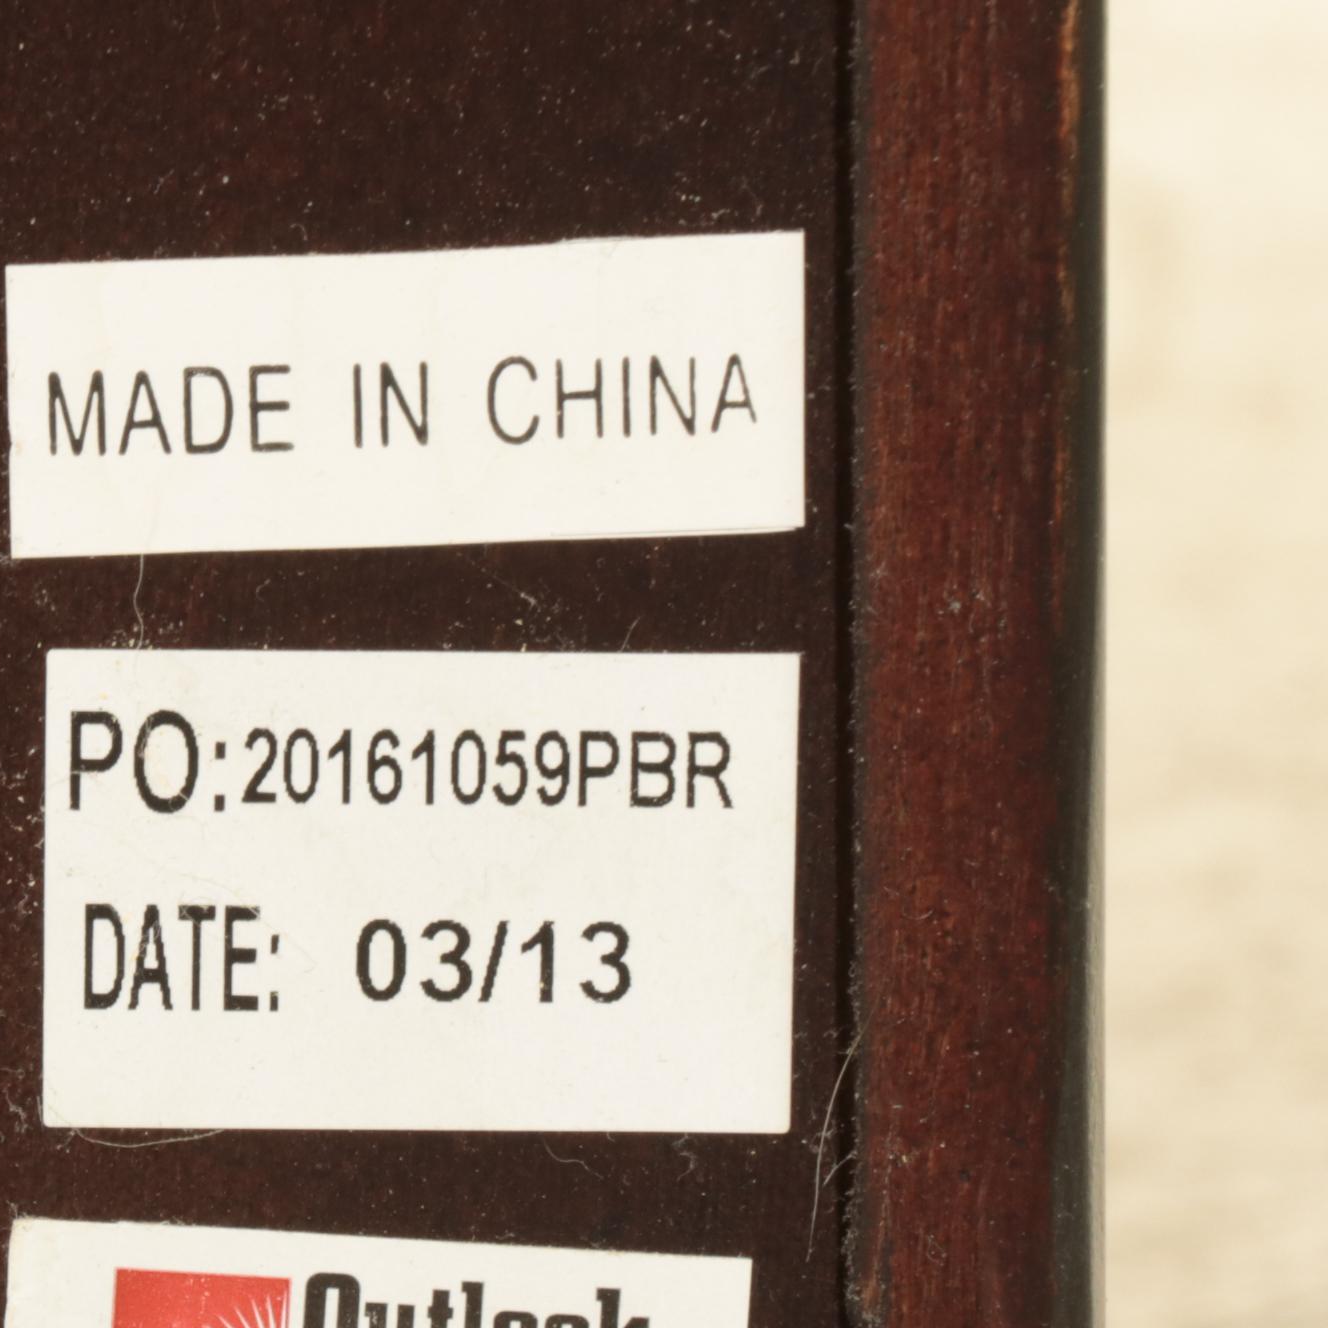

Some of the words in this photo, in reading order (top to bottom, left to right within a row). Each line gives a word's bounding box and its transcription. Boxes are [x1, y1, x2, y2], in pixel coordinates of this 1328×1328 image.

[48, 364, 294, 456] MADE
[352, 362, 429, 448] IN
[488, 353, 757, 445] CHINA
[83, 903, 279, 1013] DATE:
[356, 919, 632, 1003] 03/13
